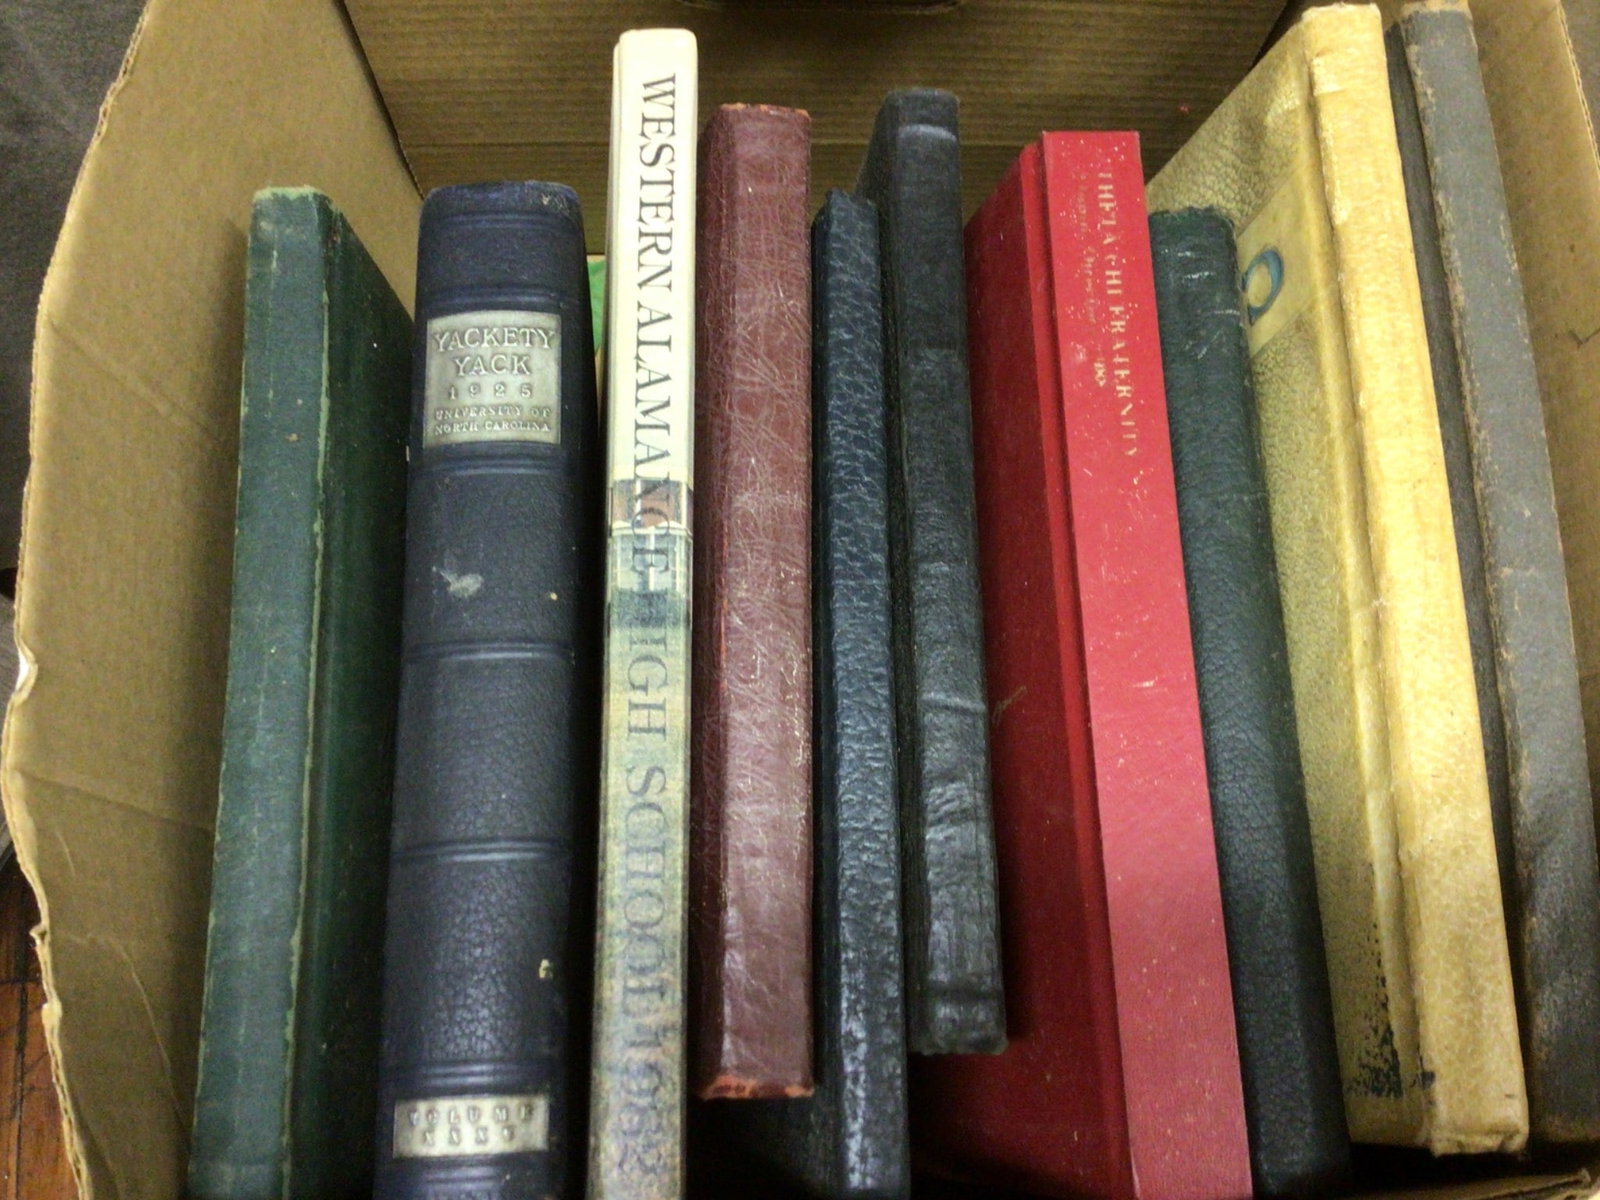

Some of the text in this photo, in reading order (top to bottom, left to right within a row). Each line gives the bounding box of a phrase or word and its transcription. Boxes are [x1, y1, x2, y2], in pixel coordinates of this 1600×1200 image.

[637, 72, 677, 293] WESTERN
[432, 327, 556, 353] YACKETY
[1097, 171, 1138, 457] THETA CHI FRATERNITY
[448, 383, 534, 400] 1925
[453, 354, 532, 376] YACK
[434, 407, 552, 421] UNIVERSITY OF
[434, 419, 552, 436] NORTH CAROLINA
[631, 300, 674, 576] ALAMANCE
[627, 588, 670, 742] HIGH
[622, 766, 668, 1019] SCHOOL
